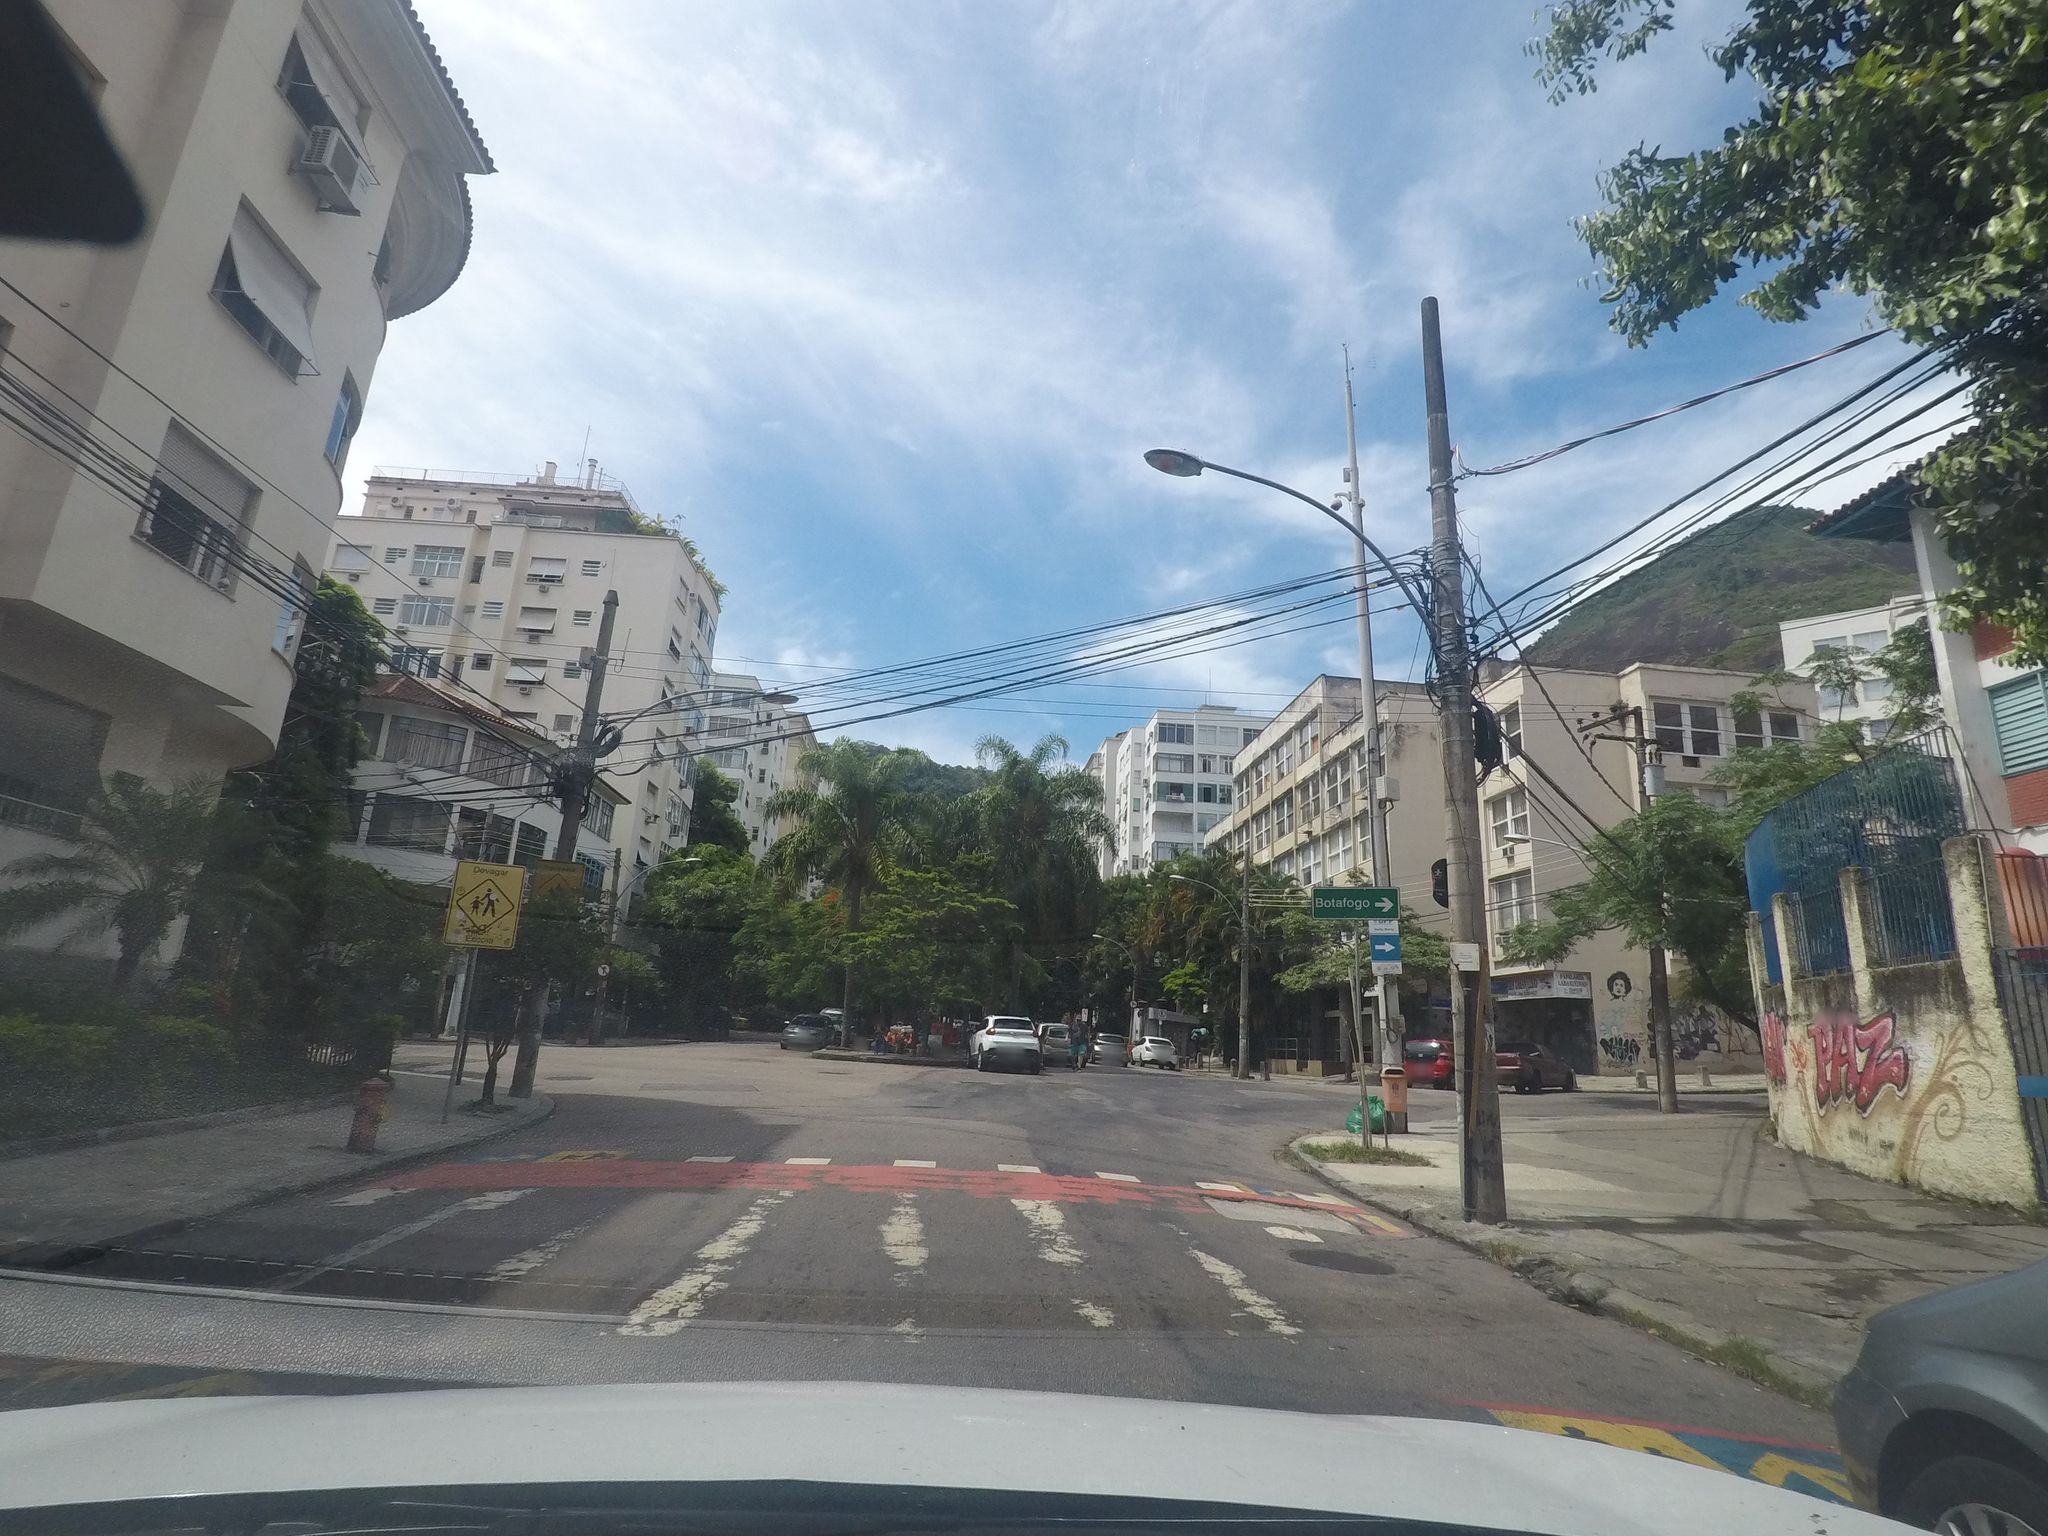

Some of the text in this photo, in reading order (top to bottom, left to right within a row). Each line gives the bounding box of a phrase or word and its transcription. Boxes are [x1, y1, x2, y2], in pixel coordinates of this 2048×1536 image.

[472, 865, 509, 876] Devagar
[1314, 897, 1370, 910] Botafogo
[1807, 1008, 1911, 1118] PAZ
